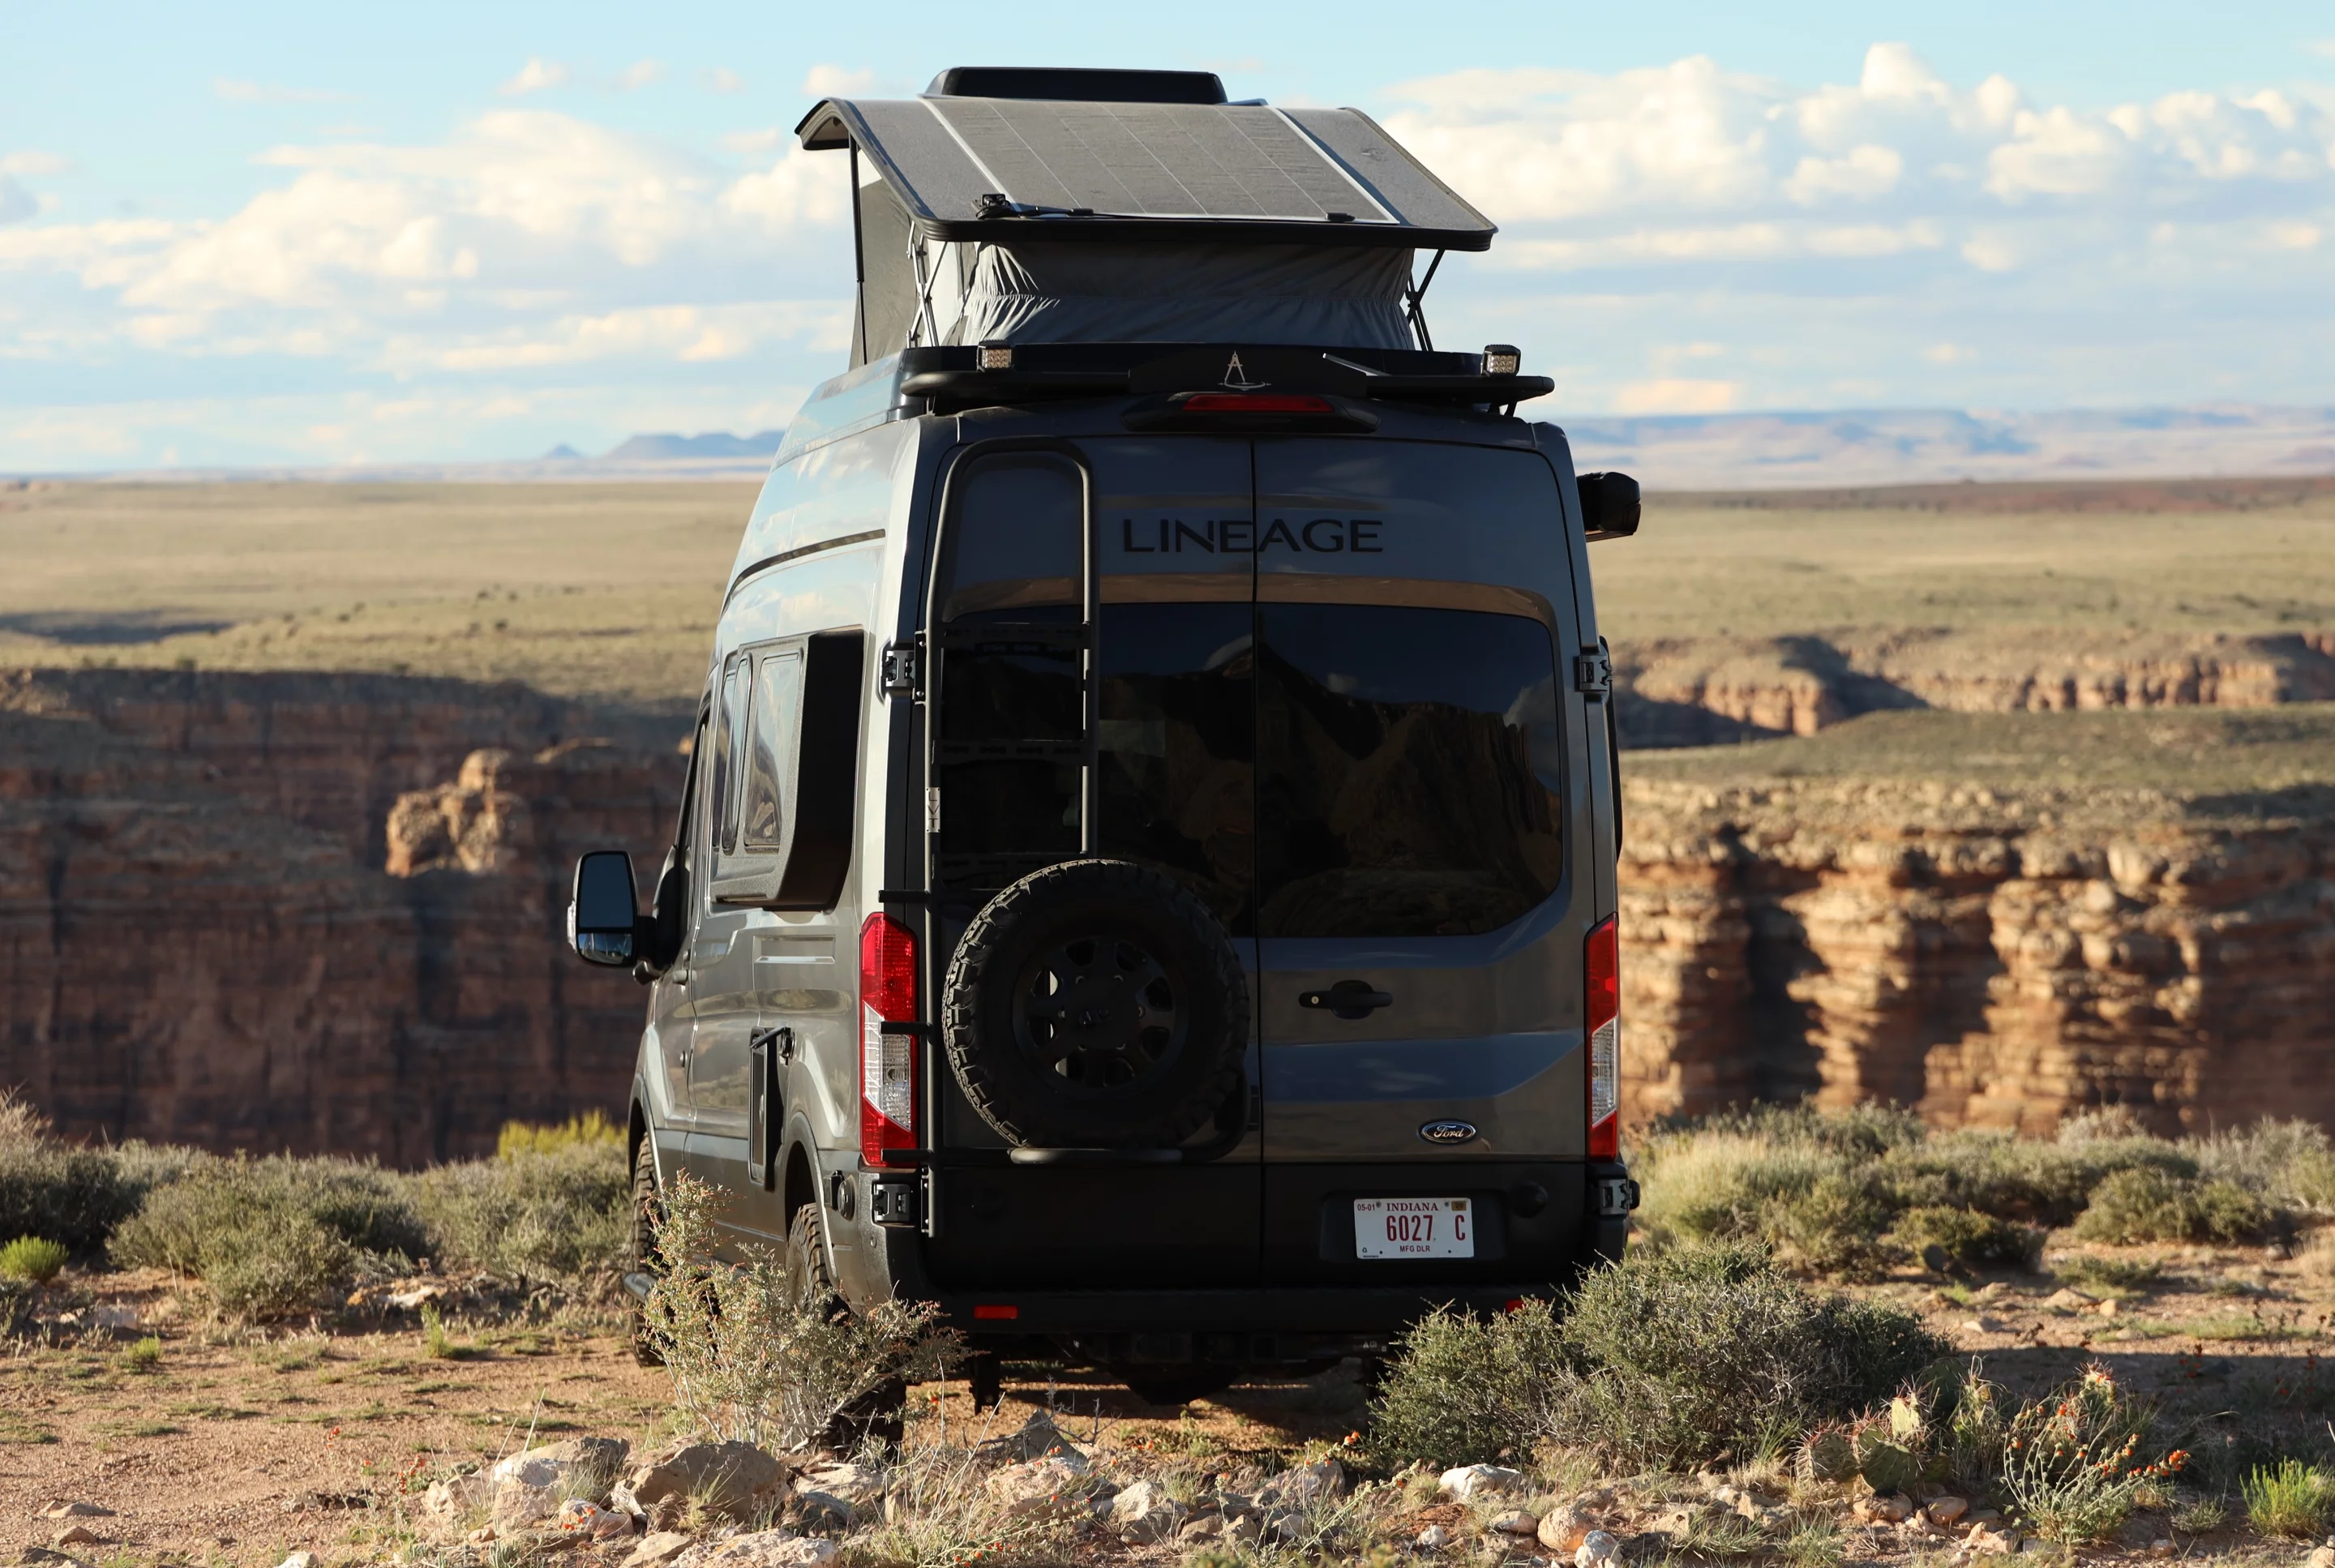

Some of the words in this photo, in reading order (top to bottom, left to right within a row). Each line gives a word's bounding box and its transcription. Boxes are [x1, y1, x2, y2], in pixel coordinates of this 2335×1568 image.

[1123, 518, 1384, 554] LINEAGE
[928, 790, 940, 829] LVT
[1433, 1125, 1464, 1138] Ford
[1357, 1203, 1375, 1211] 05-01
[1386, 1202, 1439, 1211] INDIANA
[1386, 1215, 1433, 1241] 6027
[1455, 1215, 1466, 1240] C
